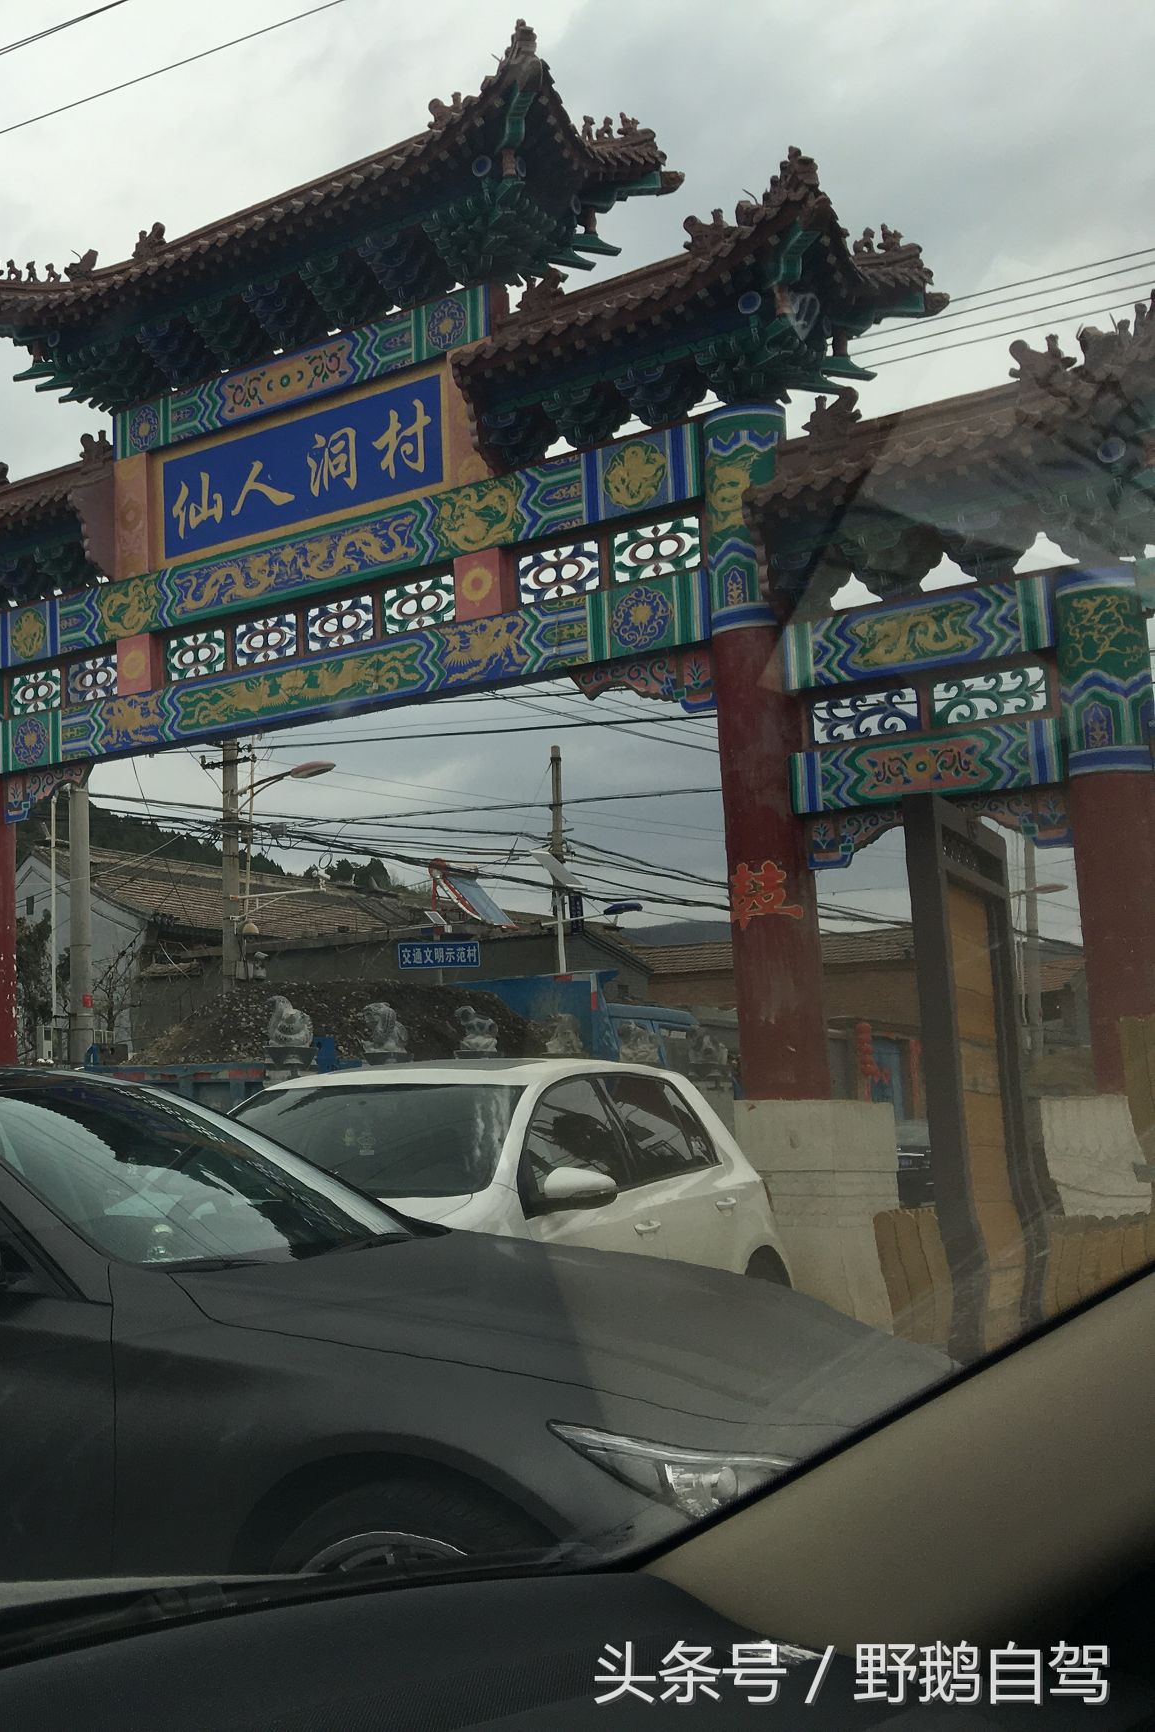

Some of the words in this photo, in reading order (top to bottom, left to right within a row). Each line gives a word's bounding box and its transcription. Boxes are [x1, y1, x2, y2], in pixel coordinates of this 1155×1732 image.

[172, 399, 431, 539] 仙人洞村
[401, 946, 477, 964] 交通文明示范村
